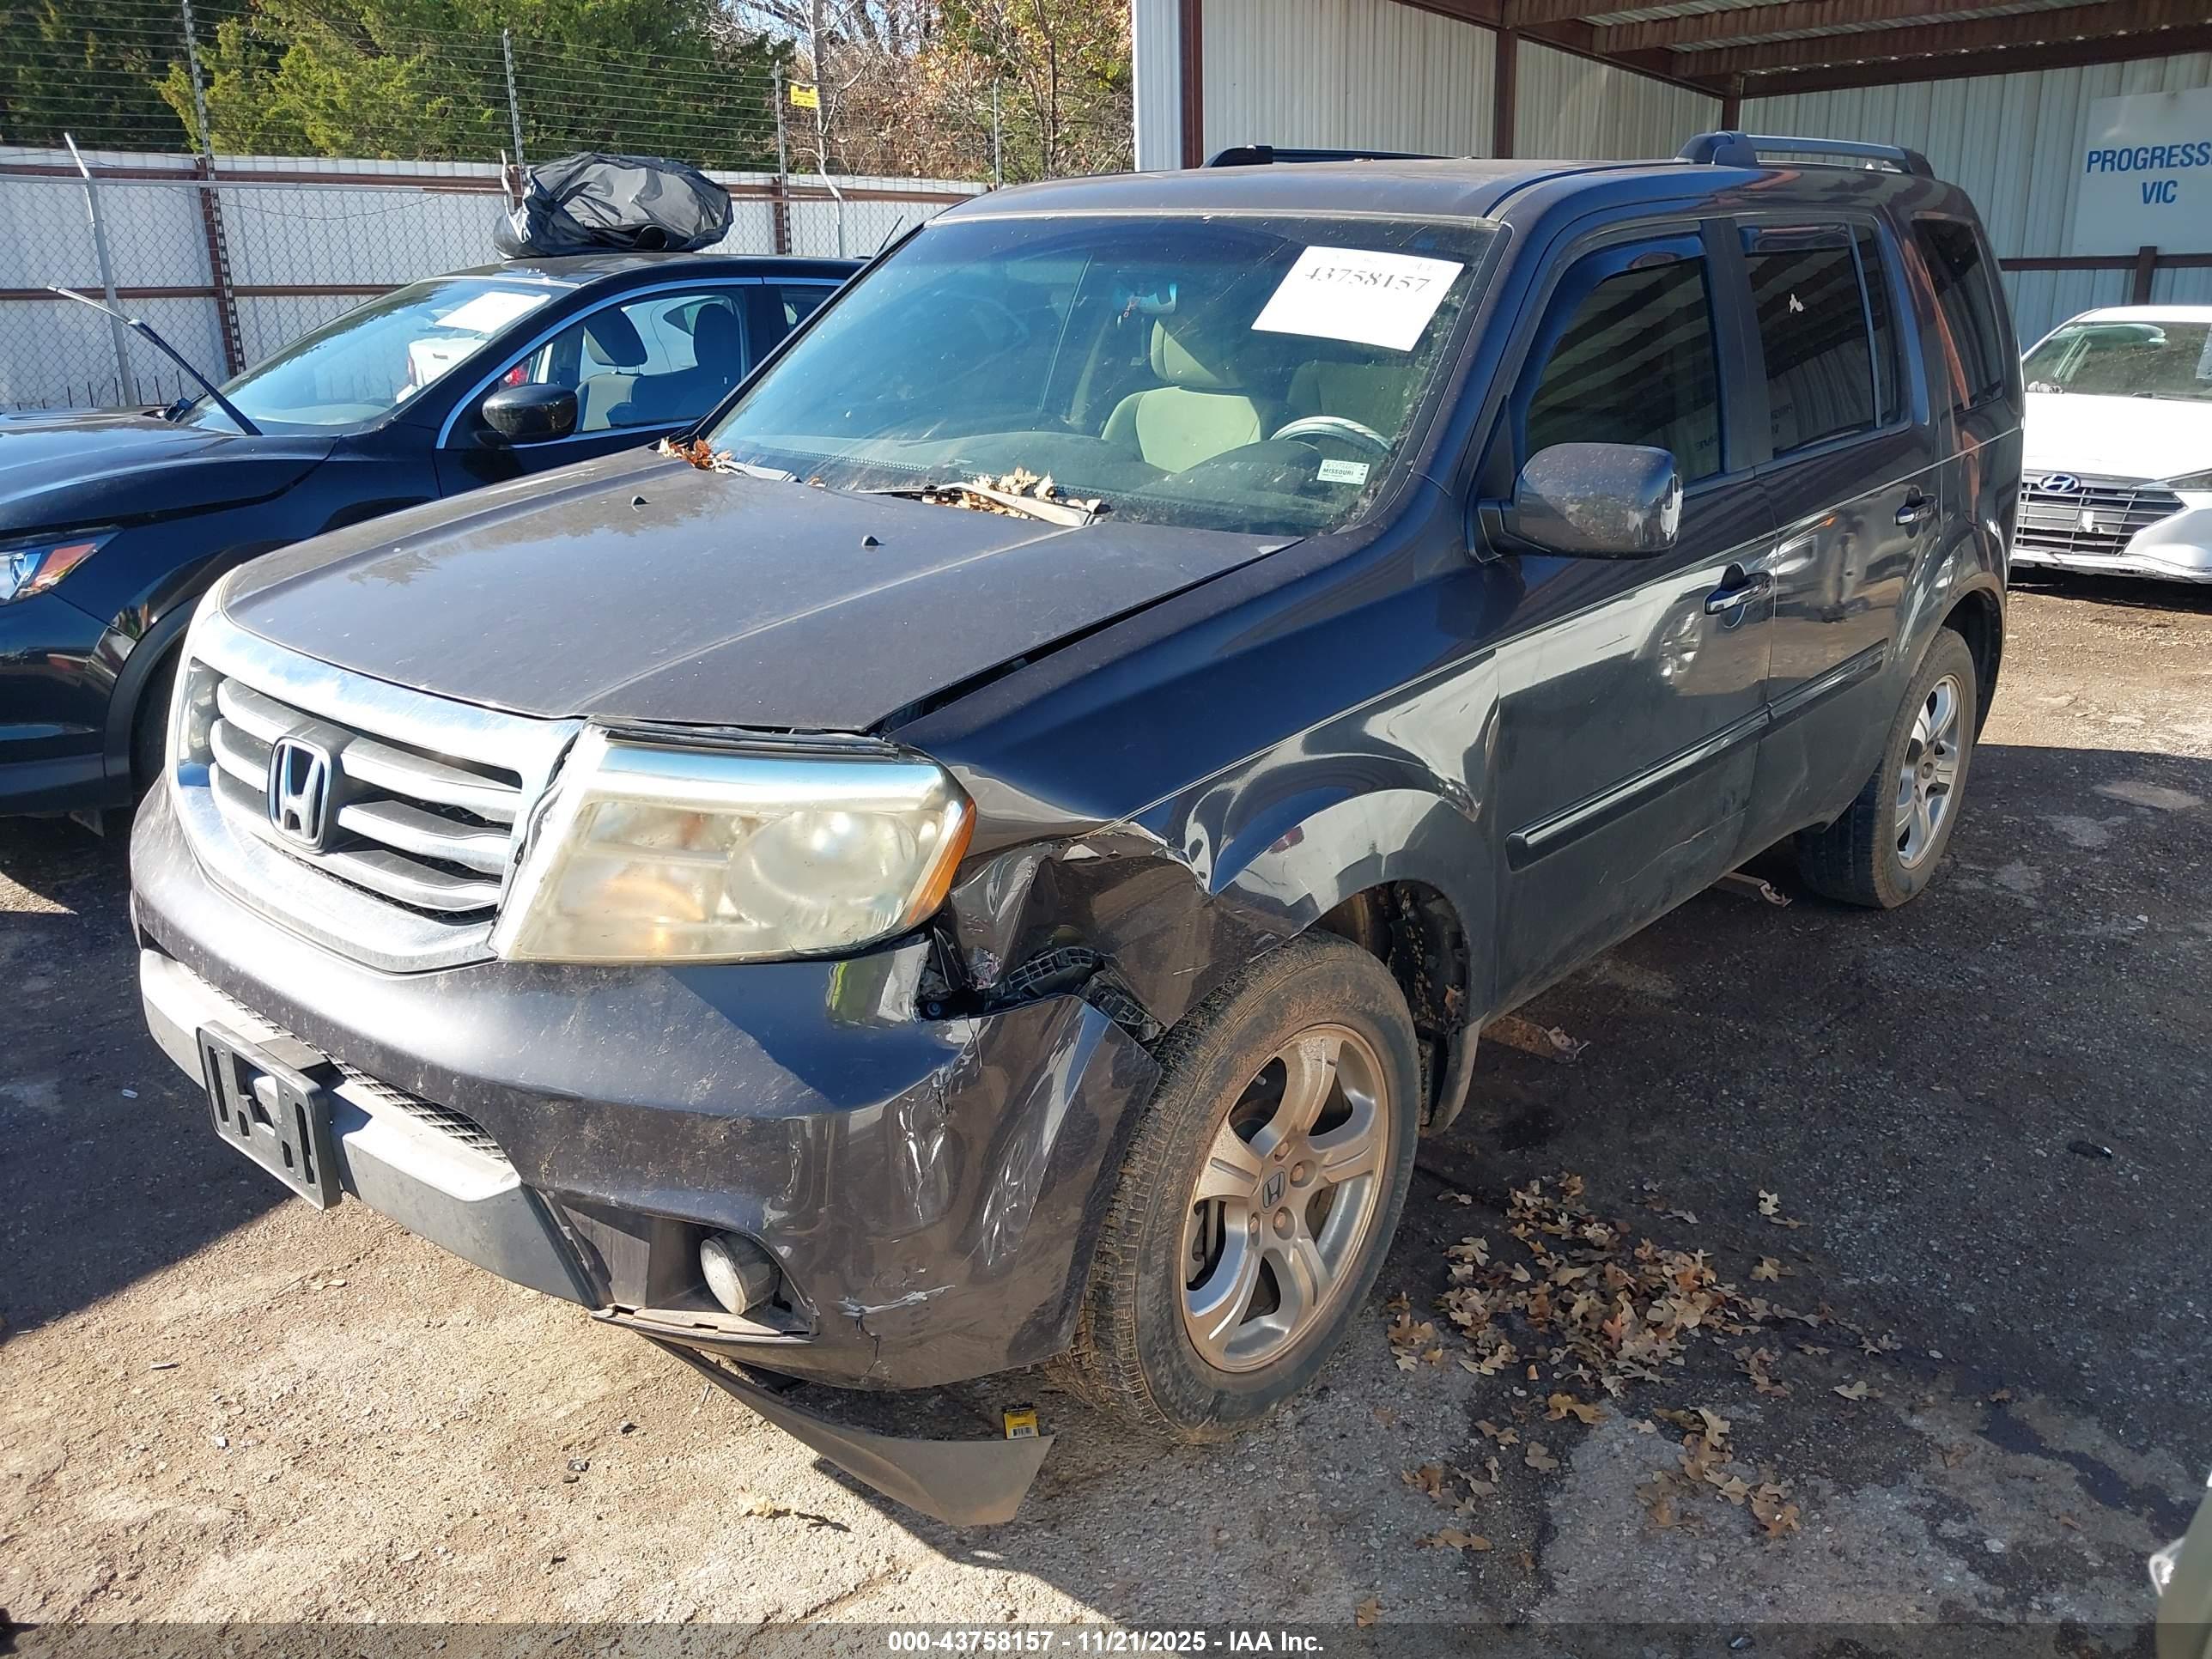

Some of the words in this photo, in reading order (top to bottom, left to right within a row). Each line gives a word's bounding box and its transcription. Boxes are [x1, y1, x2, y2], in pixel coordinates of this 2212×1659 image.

[2087, 142, 2212, 173] PROGRESS
[2142, 179, 2178, 204] VIC
[1304, 266, 1431, 293] 43758157
[1322, 467, 1354, 477] MISSOURI
